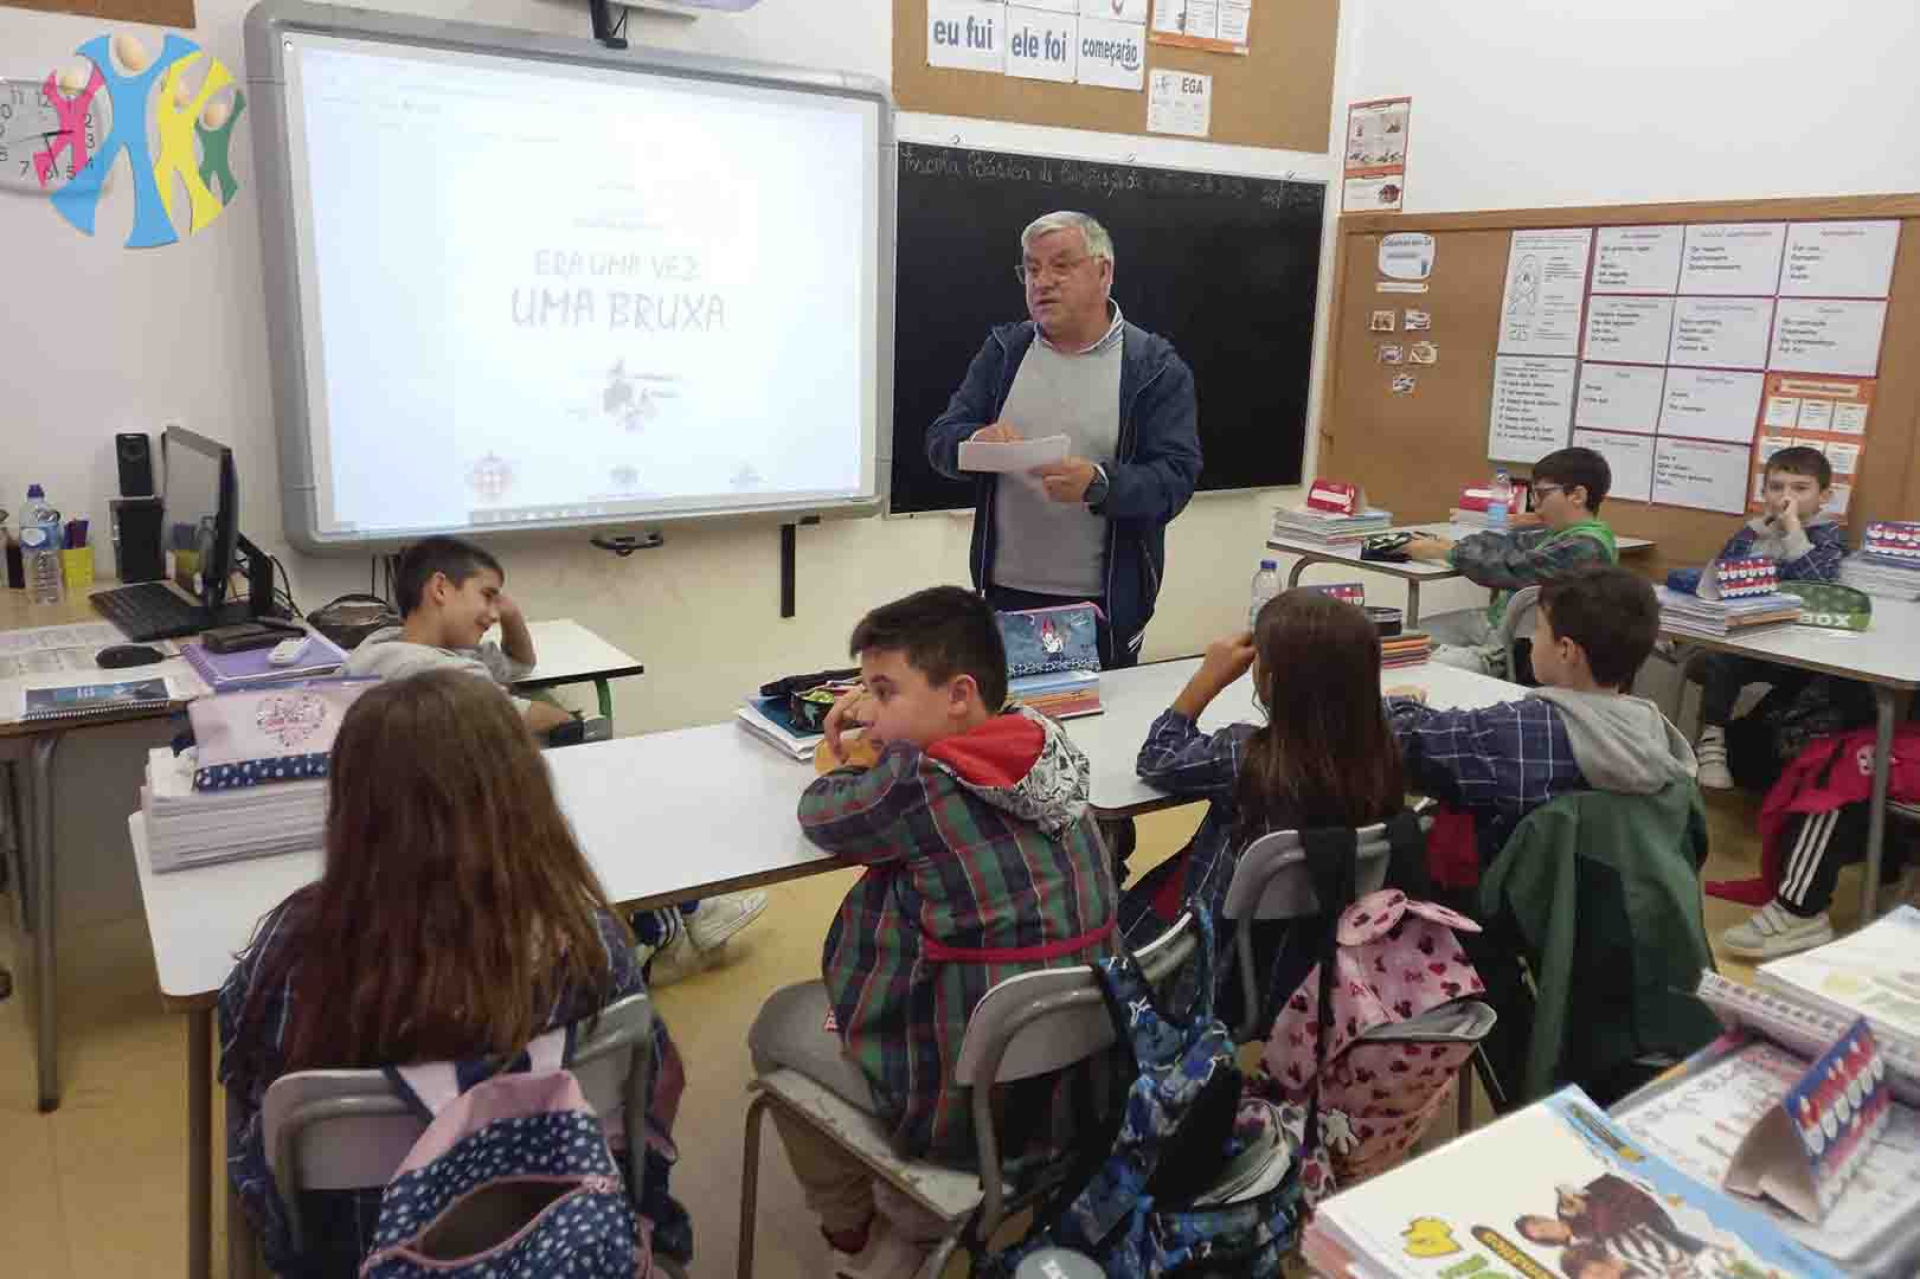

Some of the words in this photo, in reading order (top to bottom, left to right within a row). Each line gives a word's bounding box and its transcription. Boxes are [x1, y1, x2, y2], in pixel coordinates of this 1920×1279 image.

[933, 20, 959, 48] eu
[966, 15, 993, 49] fui
[1012, 28, 1039, 59] ele
[1045, 29, 1067, 62] foi
[1182, 76, 1204, 95] EGA
[86, 133, 96, 149] 3
[19, 160, 30, 178] 7
[510, 286, 595, 329] UMA
[608, 291, 730, 332] BRUXA
